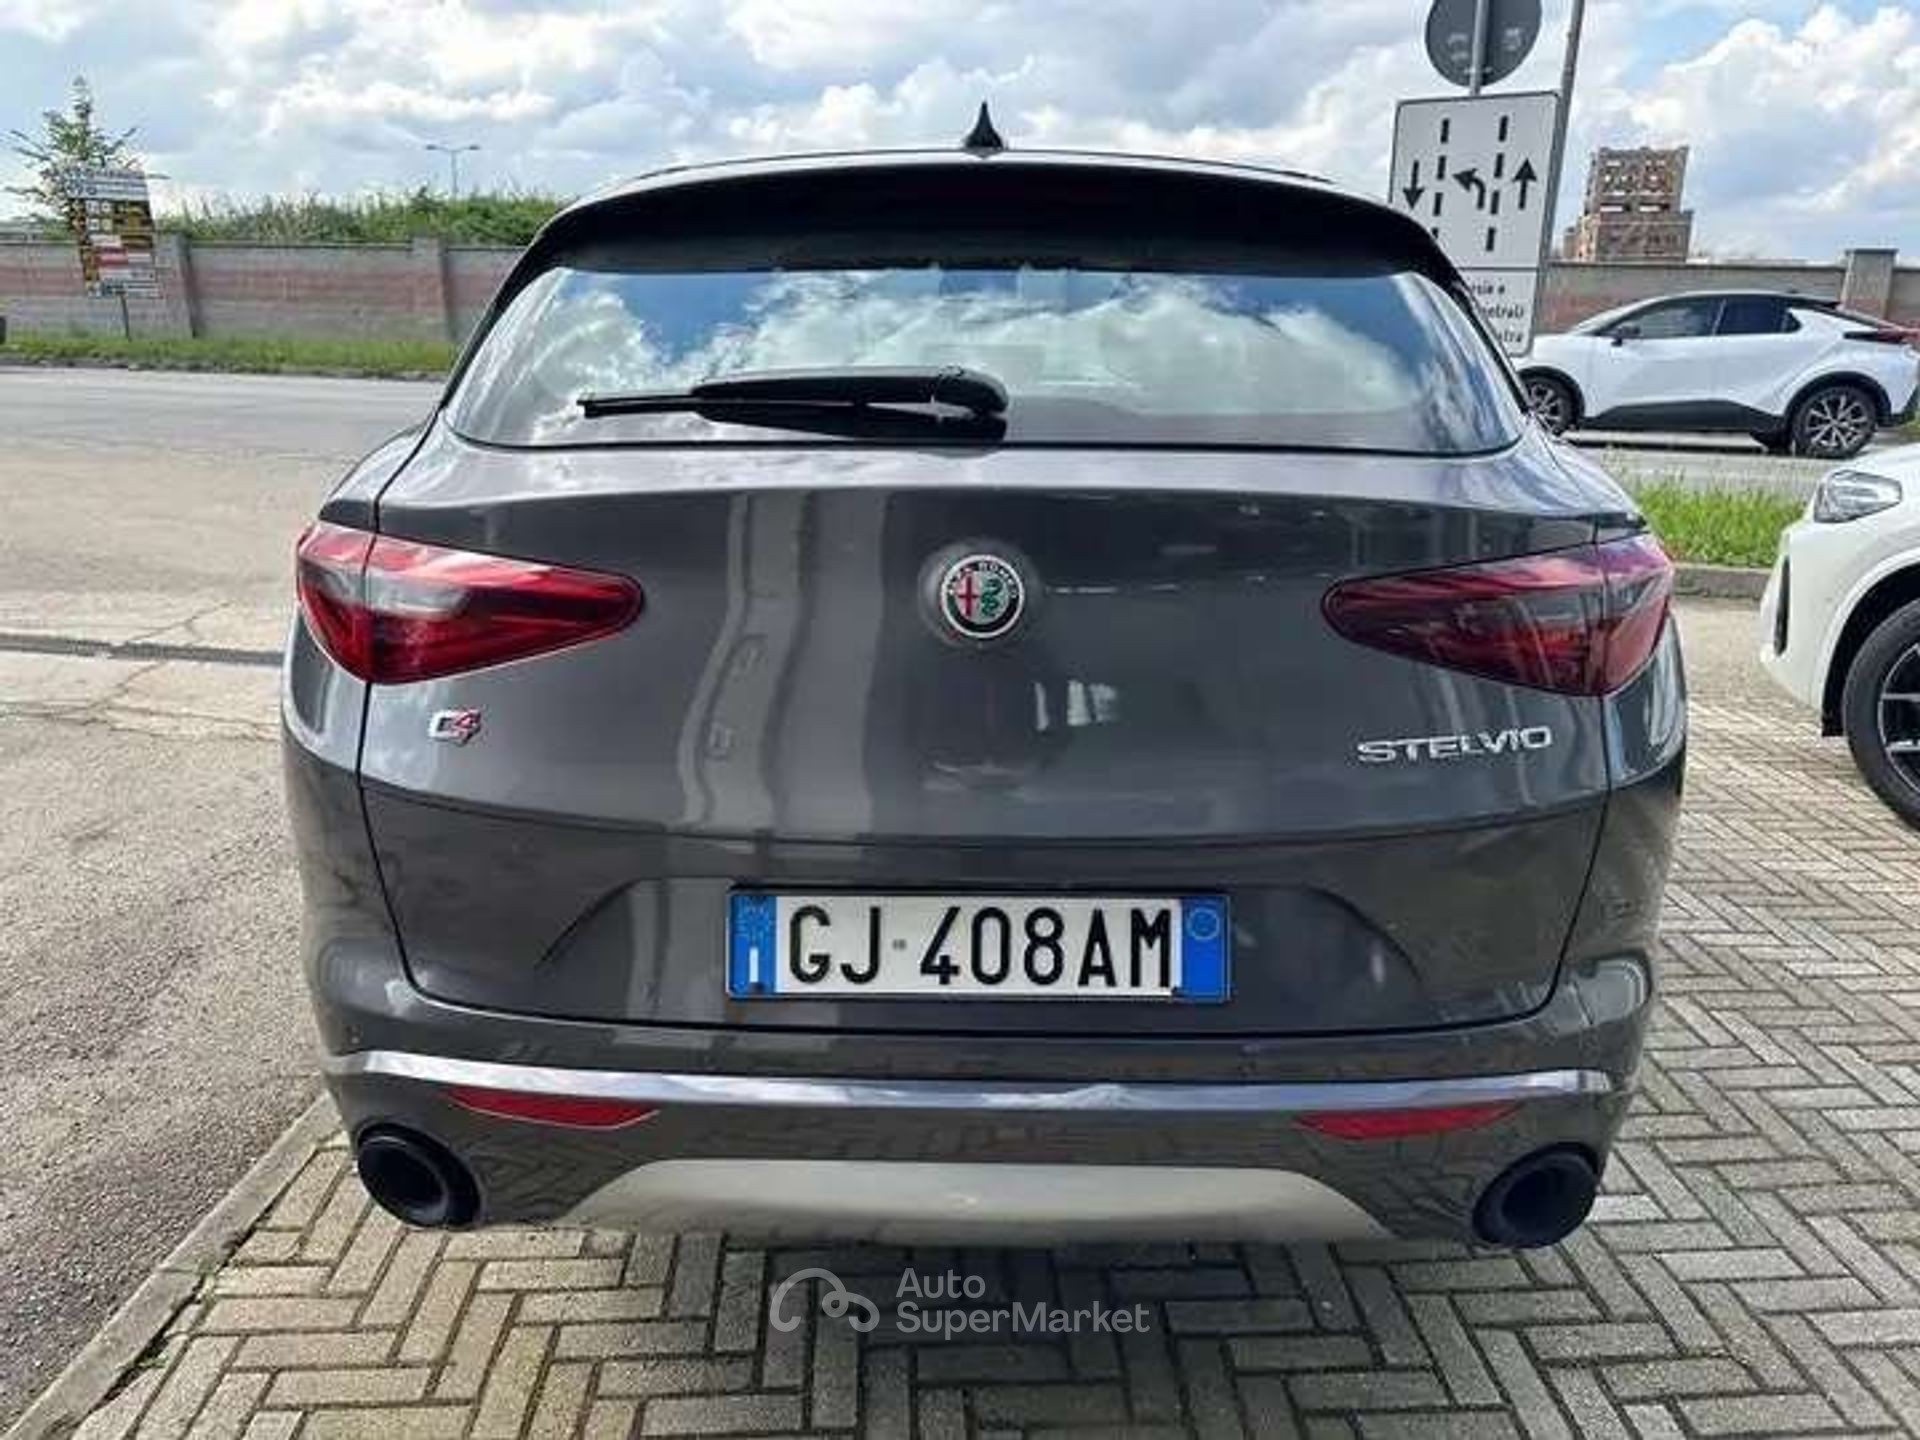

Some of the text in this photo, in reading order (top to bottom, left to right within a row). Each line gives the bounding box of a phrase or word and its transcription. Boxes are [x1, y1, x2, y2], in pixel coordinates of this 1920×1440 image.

[1357, 726, 1551, 762] STELVIO
[789, 904, 1172, 988] GJ 408AM
